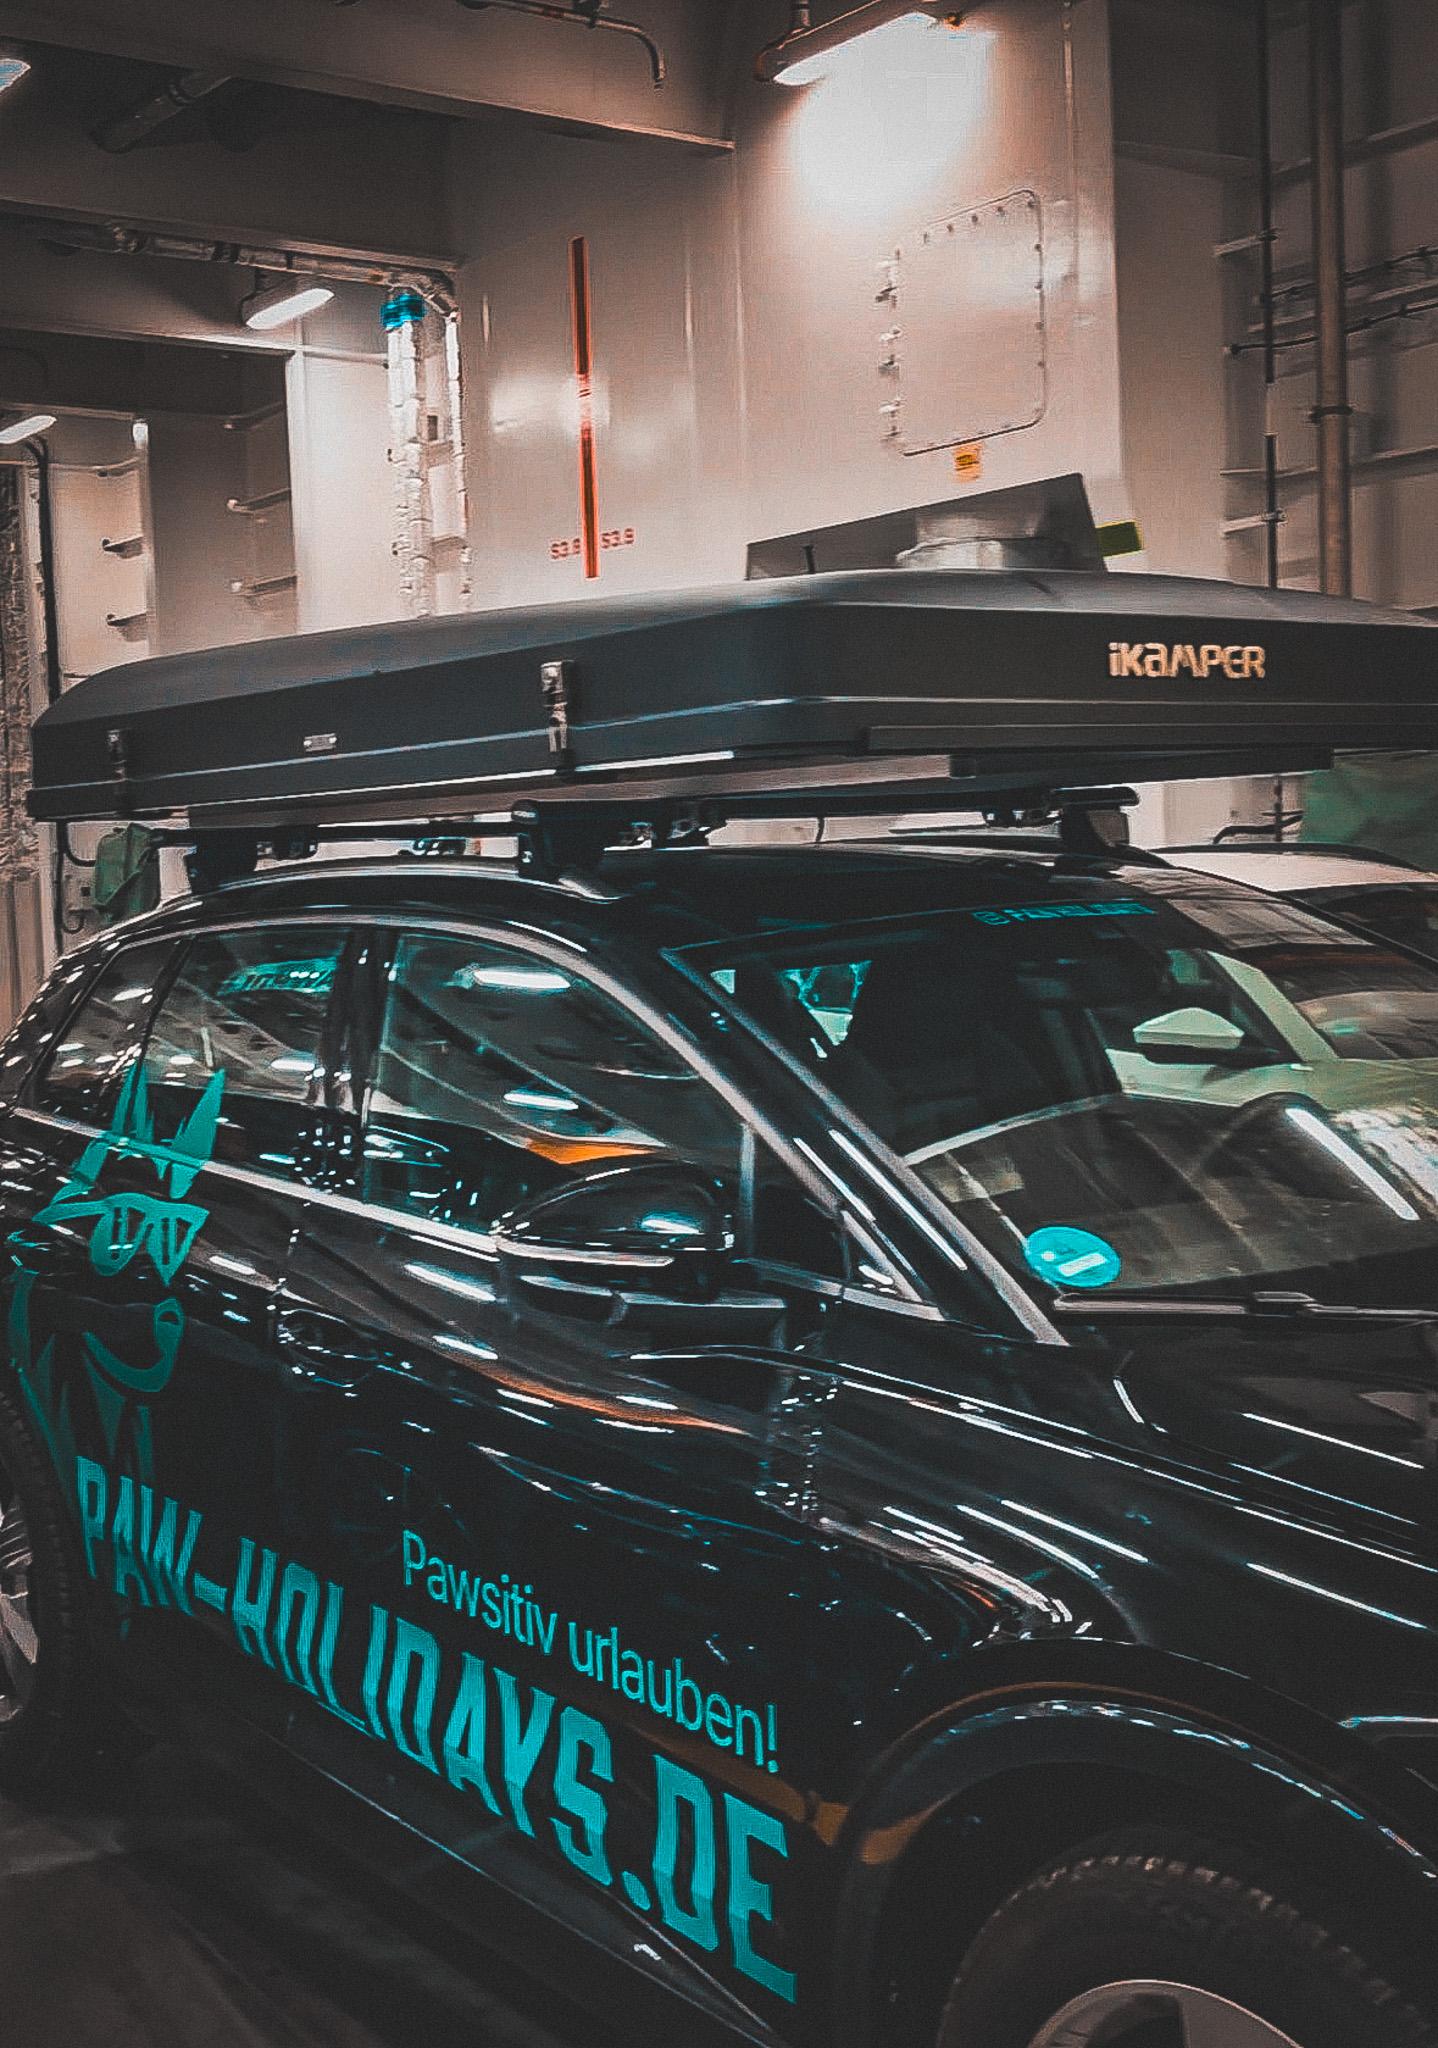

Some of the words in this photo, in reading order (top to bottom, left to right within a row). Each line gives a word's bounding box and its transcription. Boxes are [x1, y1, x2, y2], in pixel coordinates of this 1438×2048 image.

[74, 1455, 798, 2004] PAW-HOLIDAYS.DE
[402, 1529, 559, 1656] Pawsitiv
[567, 1621, 779, 1774] urlauben!
